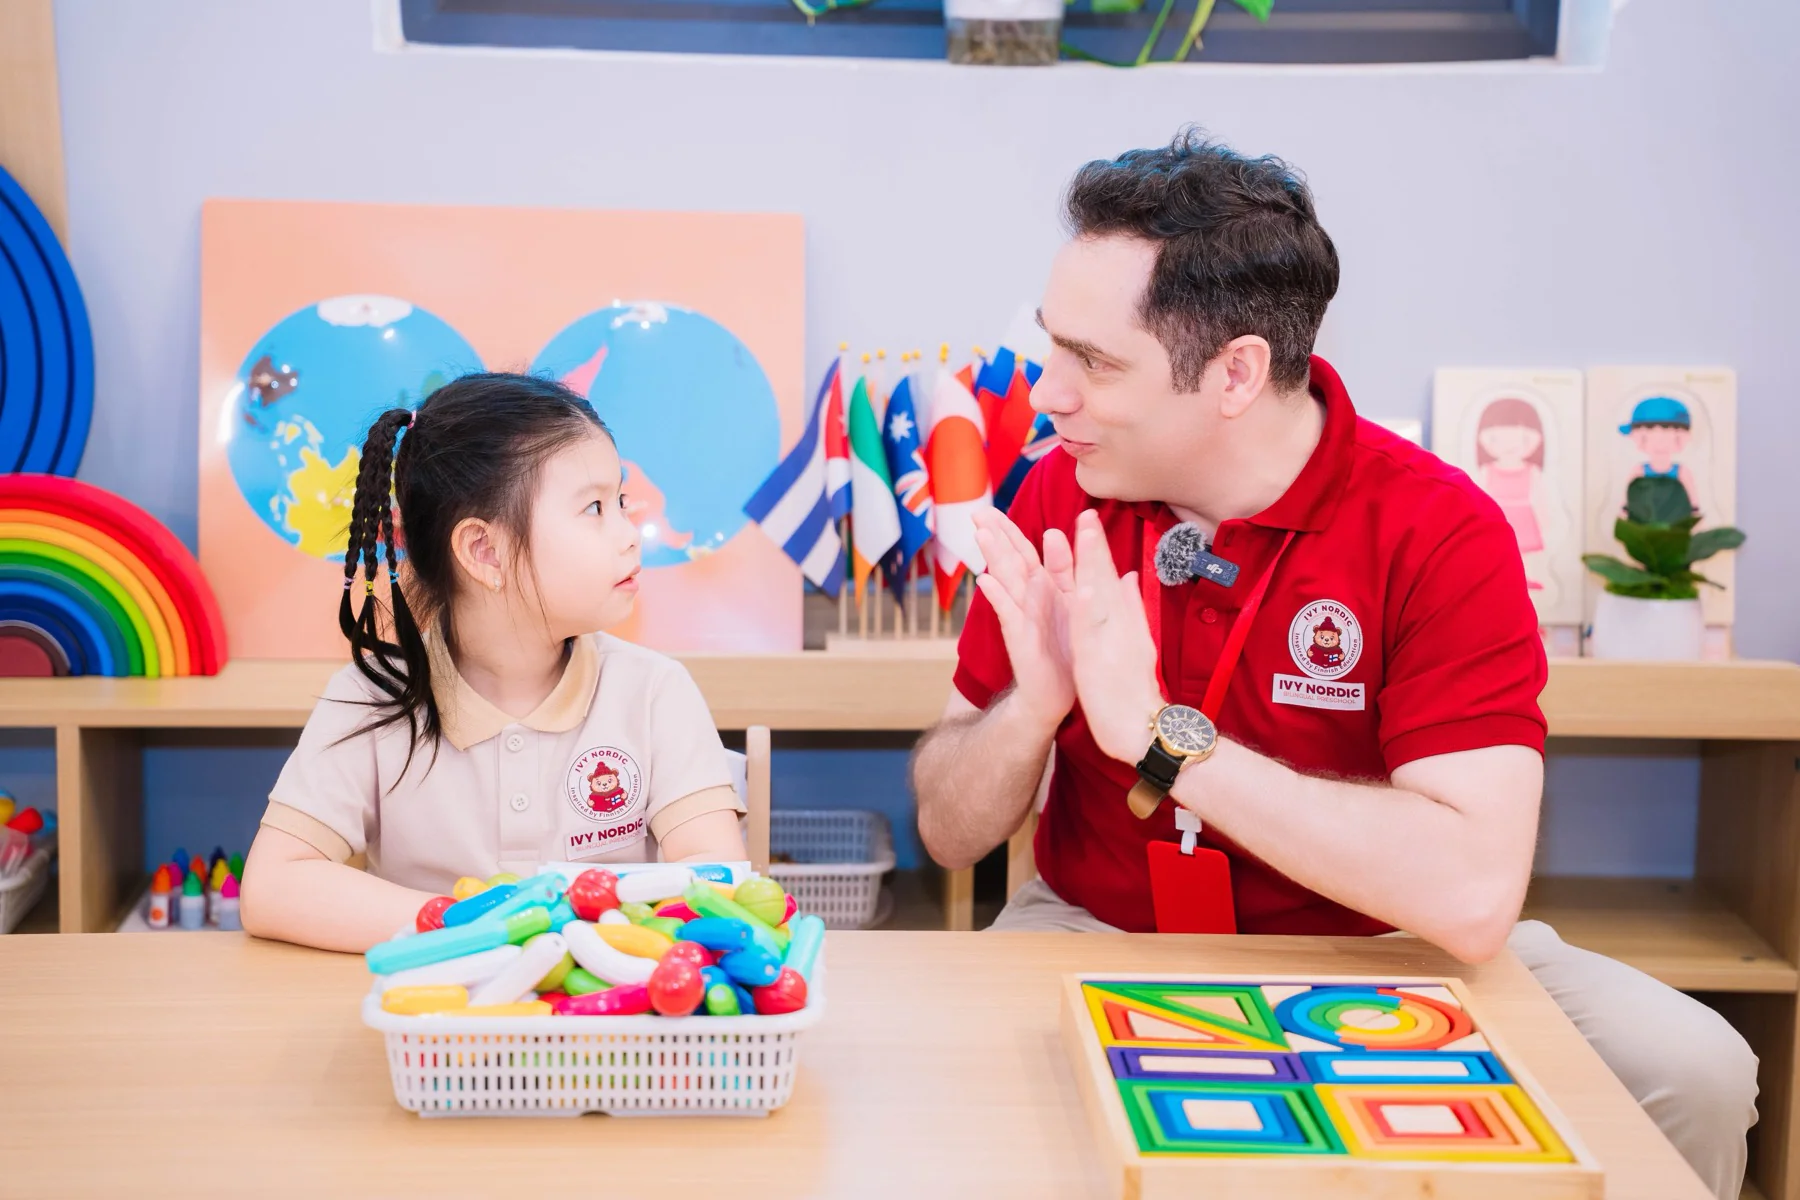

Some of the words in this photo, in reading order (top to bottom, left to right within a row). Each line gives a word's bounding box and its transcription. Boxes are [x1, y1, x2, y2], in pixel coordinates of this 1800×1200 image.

[1304, 607, 1318, 621] IVY
[1322, 605, 1352, 627] NORDIC
[1295, 633, 1306, 662] Inspired
[1306, 660, 1313, 669] by
[1314, 665, 1339, 674] Finnish
[1340, 639, 1358, 669] Education
[1279, 679, 1303, 691] IVY
[1306, 684, 1360, 698] NORDIC
[1284, 691, 1315, 701] BILINGUAL
[1317, 695, 1356, 704] PRESCHOOL
[575, 757, 588, 773] IVY
[591, 750, 628, 765] NORDIC
[571, 787, 588, 813] Inspired
[589, 810, 597, 818] by
[599, 807, 624, 818] Finnish
[625, 773, 638, 808] Education
[570, 832, 594, 847] IVY
[598, 818, 643, 841] NORDIC
